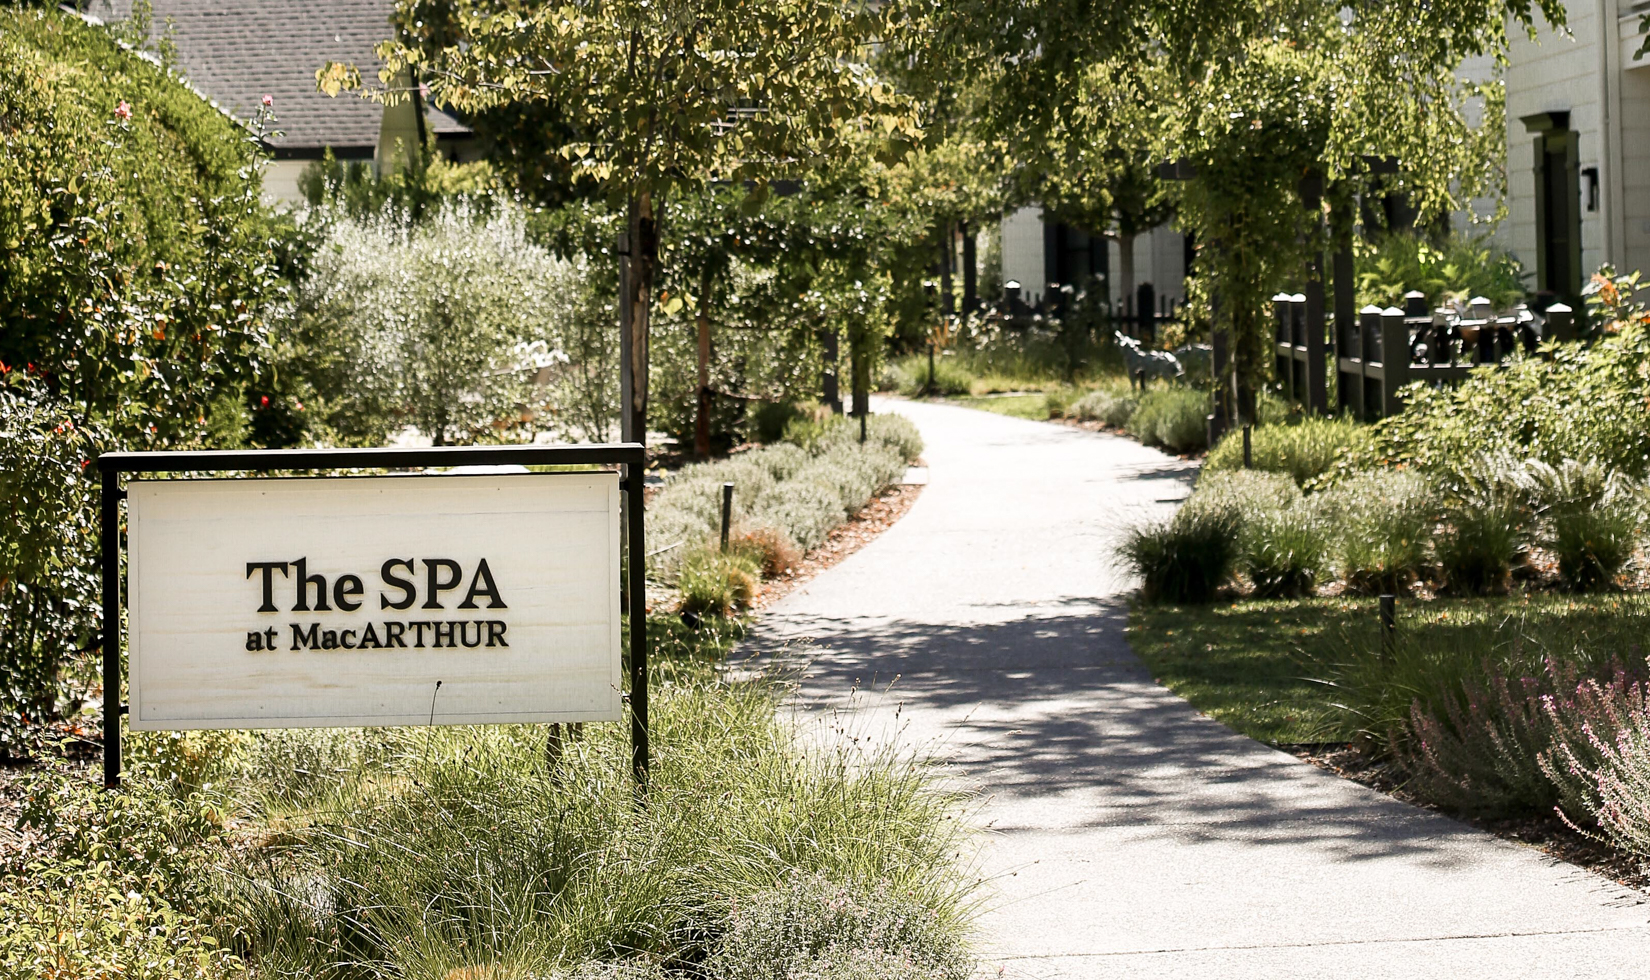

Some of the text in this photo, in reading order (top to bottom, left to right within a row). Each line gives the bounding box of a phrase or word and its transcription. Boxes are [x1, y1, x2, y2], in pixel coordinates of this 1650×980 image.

[246, 556, 508, 612] The SPA
[245, 620, 510, 652] at MacARTHUR
